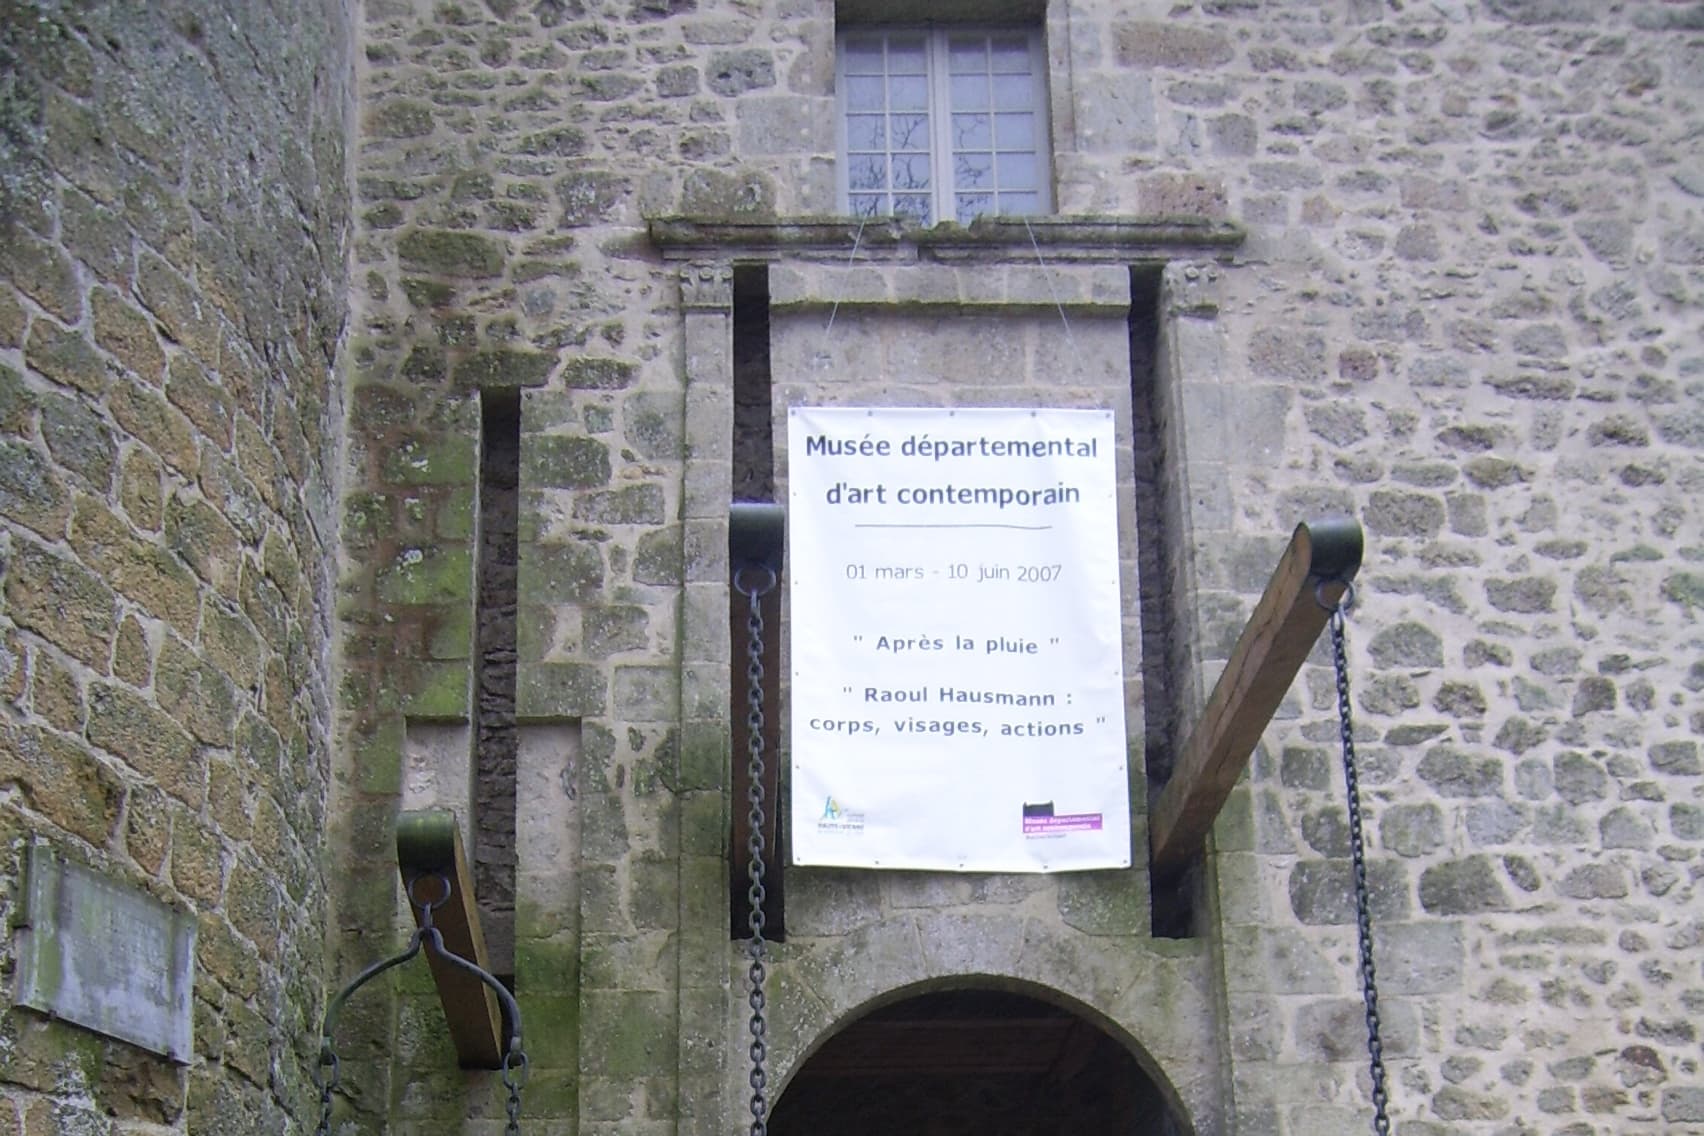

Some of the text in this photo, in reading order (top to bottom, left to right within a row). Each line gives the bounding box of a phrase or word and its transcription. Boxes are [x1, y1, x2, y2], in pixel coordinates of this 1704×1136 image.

[806, 434, 1098, 462] Musée départemental
[826, 481, 1081, 510] d'art contemporain
[846, 564, 867, 580] 01
[875, 567, 925, 580] mars
[948, 564, 968, 580] 10
[976, 564, 1010, 583] juin
[1017, 564, 1063, 583] 2007
[876, 634, 945, 654] Après
[956, 635, 975, 651] la
[986, 637, 1039, 655] pluie
[864, 687, 928, 703] Raoul
[939, 687, 1055, 707] Hausmann
[809, 718, 881, 736] corps,
[894, 717, 989, 737] visages,
[1000, 720, 1084, 737] actions
